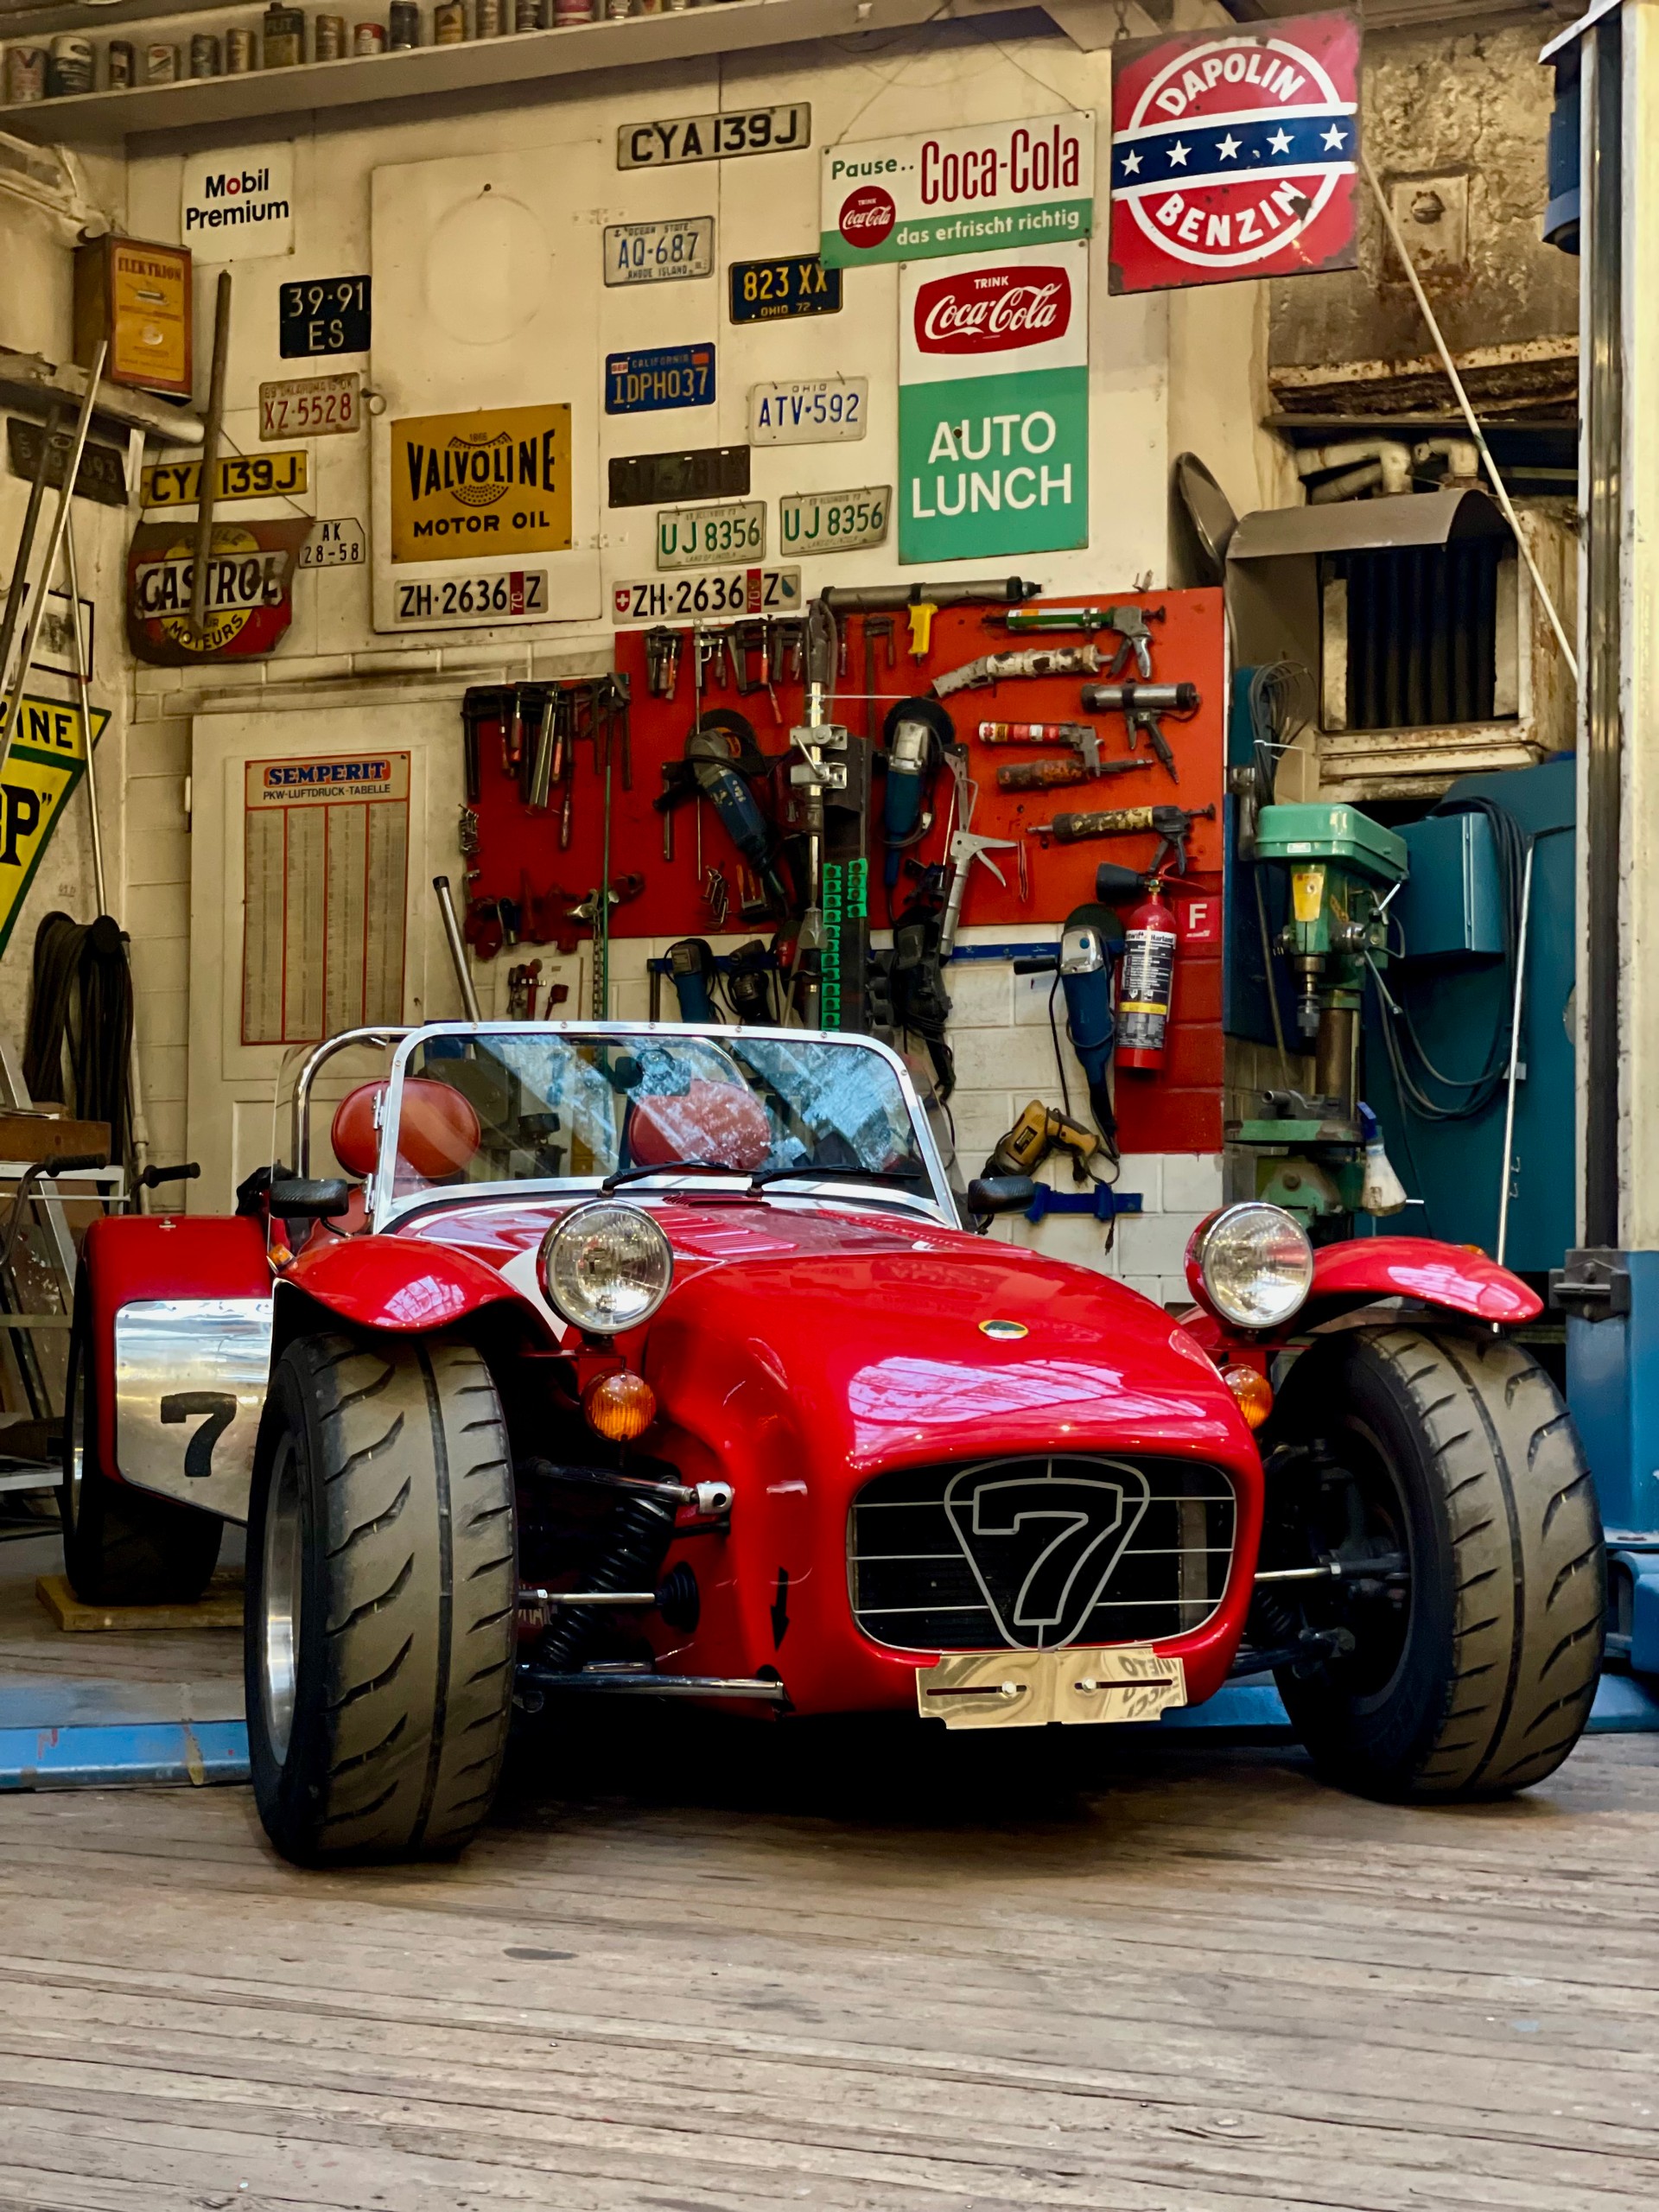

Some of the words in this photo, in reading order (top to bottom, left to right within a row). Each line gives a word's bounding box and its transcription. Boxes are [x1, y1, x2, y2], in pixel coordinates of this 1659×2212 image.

[1155, 53, 1306, 116] DAPOLIN
[631, 123, 702, 162] CYA
[715, 110, 797, 152] 139J
[920, 124, 1079, 205] Coca-Cola
[205, 169, 269, 199] Mobil
[186, 198, 289, 230] Premium
[842, 206, 892, 230] Coca-Cola
[896, 226, 931, 245] das
[935, 215, 1007, 240] erfrischt
[1012, 209, 1079, 235] richtig
[1157, 180, 1307, 247] BENZIN
[744, 266, 789, 302] 823
[798, 264, 828, 295] XX
[974, 276, 1009, 289] TRINK
[760, 305, 788, 316] OHIO
[796, 302, 810, 312] 72
[925, 283, 1063, 340] Coca-Cola
[308, 319, 344, 351] ES
[632, 353, 689, 368] CALIFORNIA
[613, 366, 708, 404] 1DPH037
[791, 383, 827, 393] OHIO
[928, 411, 1056, 463] AUTO
[407, 429, 556, 501] VALVOLINE
[912, 464, 1071, 518] LUNCH
[322, 523, 341, 541] AK
[413, 515, 500, 537] MOTOR
[512, 511, 550, 529] OIL
[662, 521, 697, 555] UJ
[705, 517, 760, 551] 8356
[785, 506, 819, 541] UJ
[828, 502, 882, 536] 8356
[304, 543, 359, 563] 28-58
[526, 576, 541, 607] Z
[764, 573, 779, 606] Z
[269, 762, 385, 785] SEMPERIT
[1190, 904, 1207, 929] F
[161, 1391, 237, 1477] 7
[973, 1477, 1123, 1625] 7
